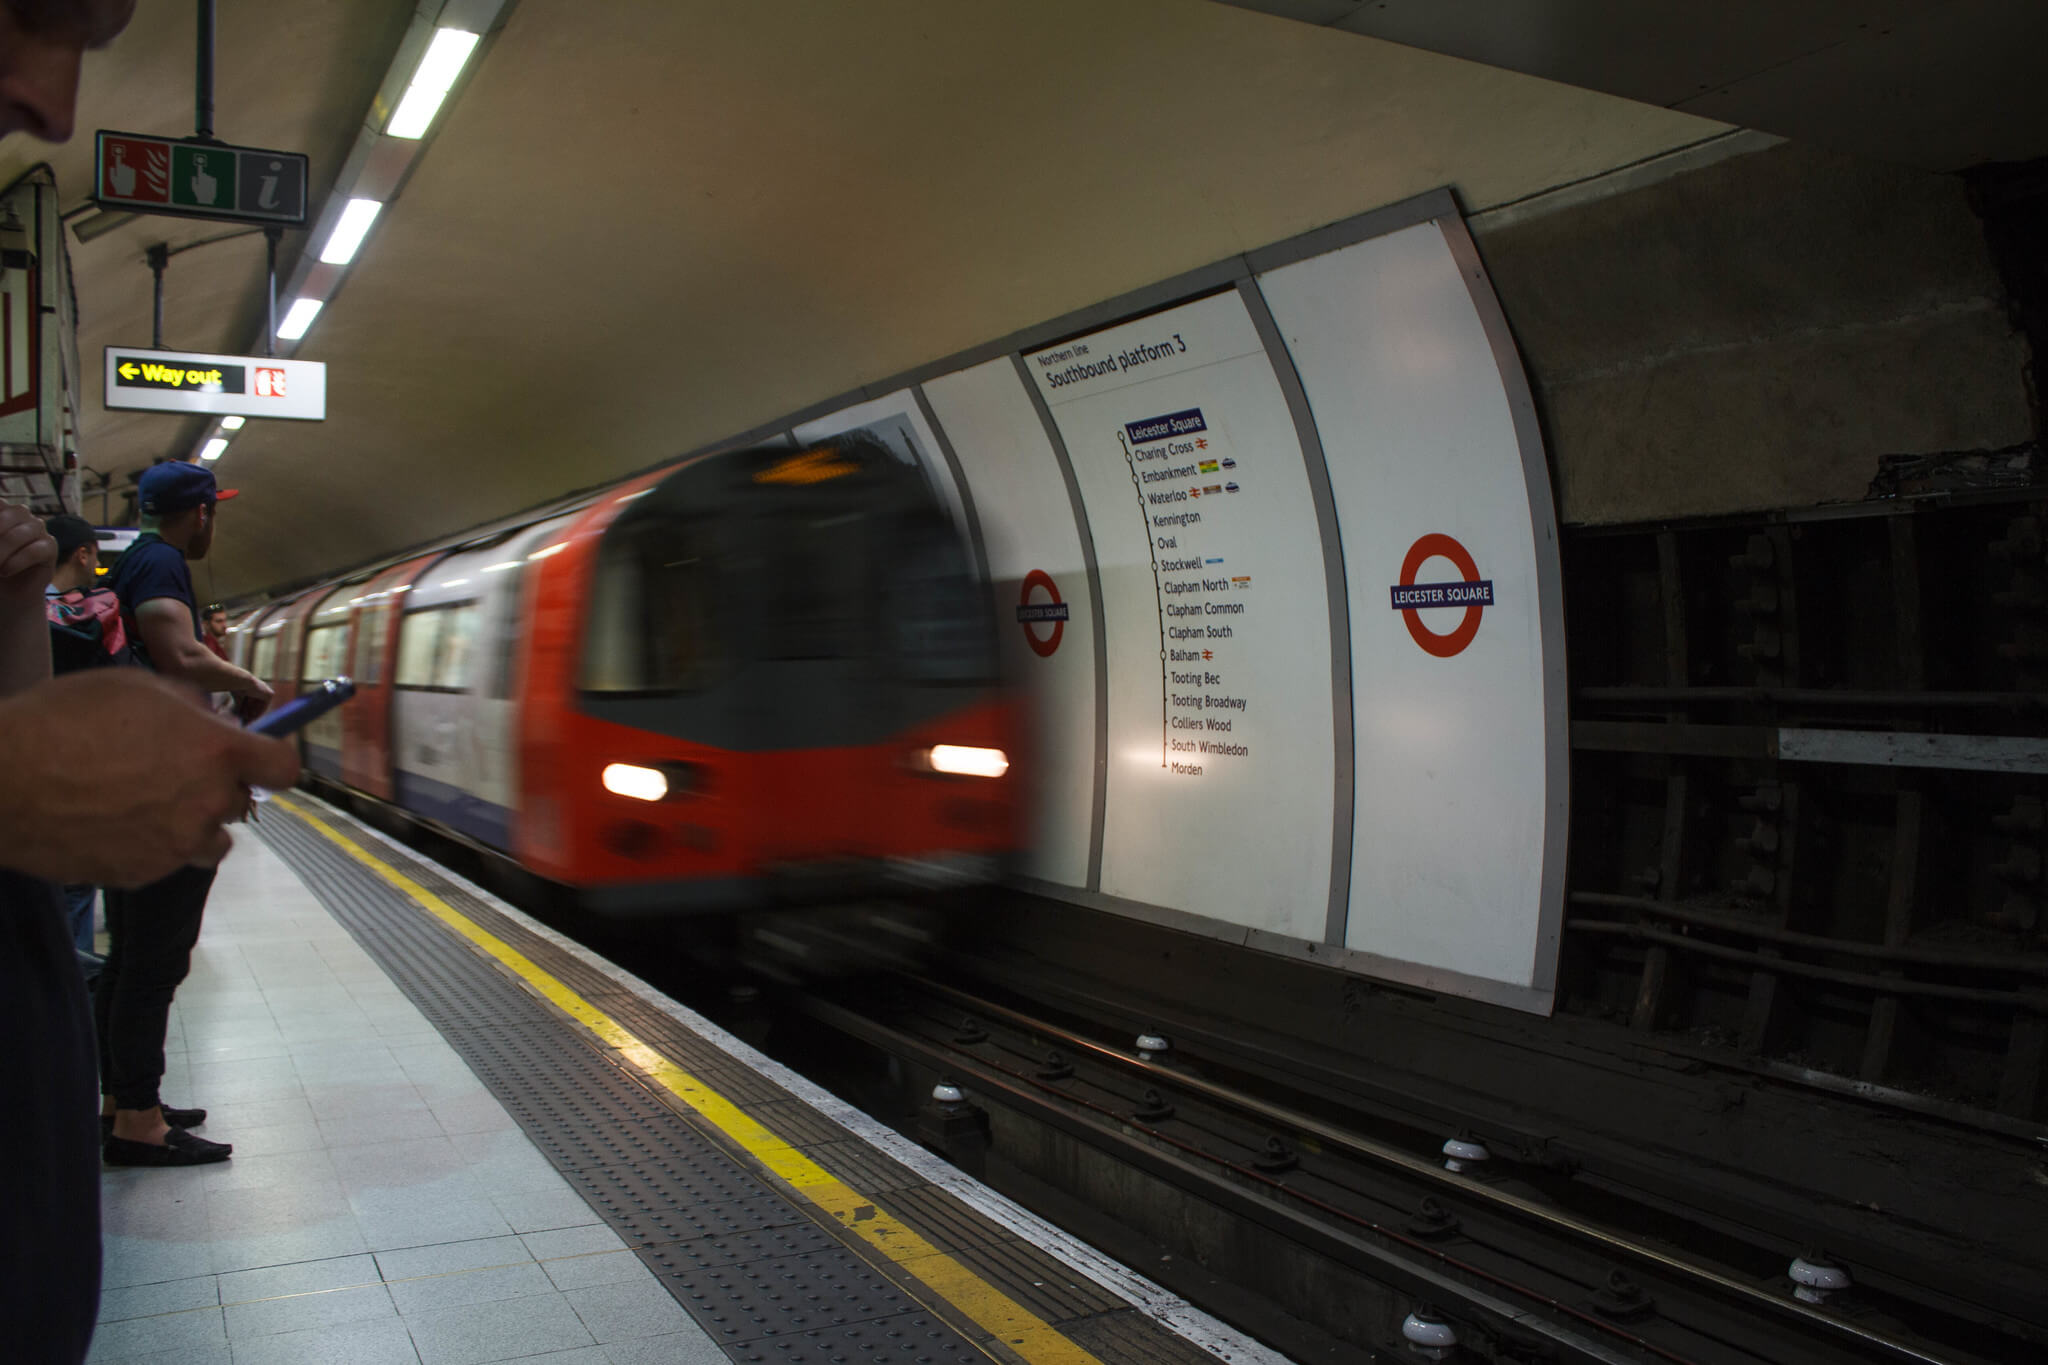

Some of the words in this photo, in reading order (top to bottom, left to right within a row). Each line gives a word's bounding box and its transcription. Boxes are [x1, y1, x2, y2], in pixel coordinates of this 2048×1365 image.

[1037, 349, 1074, 367] Northern
[1072, 344, 1089, 354] line
[1046, 355, 1117, 388] Southbound
[1118, 344, 1175, 372] platform
[1173, 334, 1186, 352] 3
[141, 363, 184, 386] Way
[186, 369, 222, 385] out
[1129, 424, 1169, 440] Leicester
[1170, 415, 1201, 433] Square
[1135, 446, 1168, 462] Charing
[1168, 441, 1194, 455] Cross
[1141, 464, 1197, 483] Embankment
[1147, 490, 1187, 505] Waterloo
[1153, 511, 1200, 527] Kennington
[1158, 536, 1177, 549] Oval
[1161, 557, 1203, 572] Stockwell
[1164, 580, 1200, 596] Clapham
[1202, 578, 1229, 592] North
[1394, 590, 1445, 604] LEICESTER
[1447, 587, 1490, 601] SQUARE
[1167, 603, 1202, 618] Clapham
[1205, 602, 1244, 615] Common
[1169, 626, 1204, 641] Clapham
[1207, 625, 1233, 638] South
[1170, 650, 1200, 661] Balham
[1171, 671, 1202, 687] Tooting
[1205, 672, 1220, 684] Bec
[1171, 694, 1202, 710] Tooting
[1205, 695, 1247, 712] Broadway
[1171, 716, 1203, 730] Colliers
[1206, 718, 1231, 732] Wood
[1171, 738, 1196, 752] South
[1199, 741, 1248, 757] Wimbledon
[1171, 762, 1203, 776] Morden
